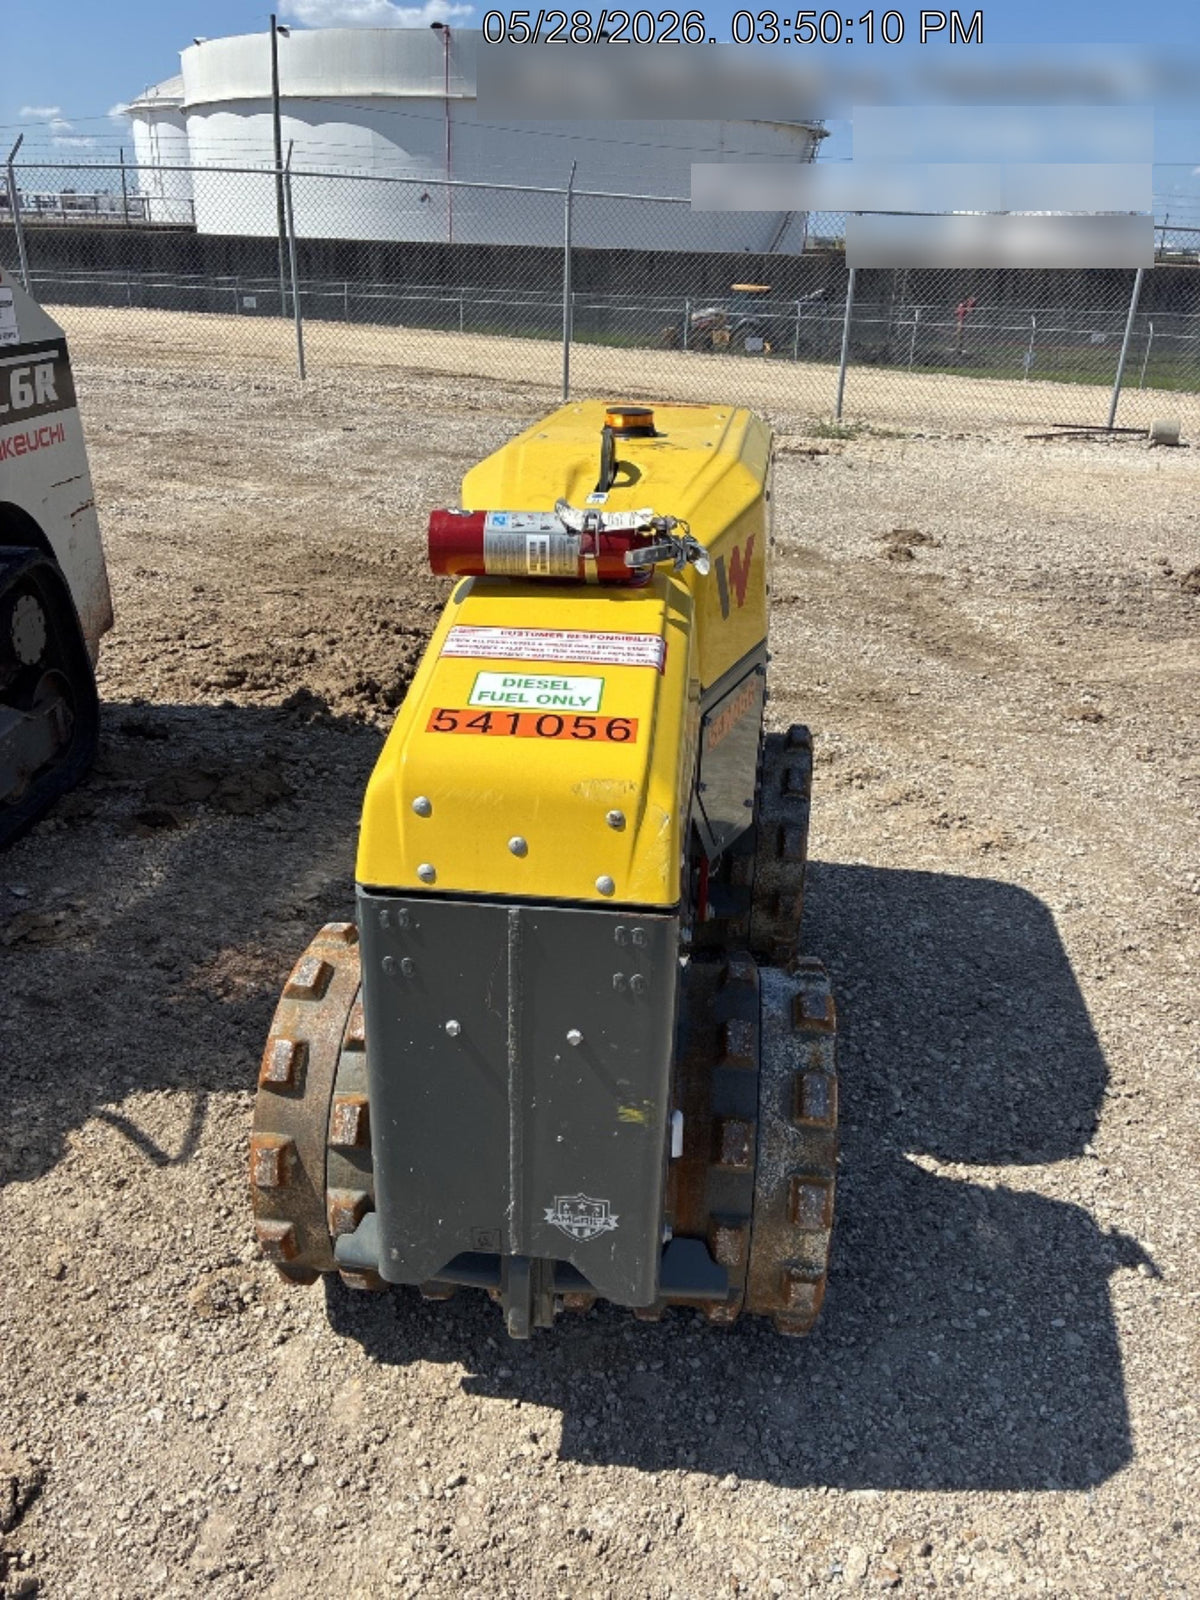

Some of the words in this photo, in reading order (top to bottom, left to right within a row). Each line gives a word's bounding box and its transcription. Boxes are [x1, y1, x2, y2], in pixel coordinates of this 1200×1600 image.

[500, 630, 564, 640] CUSTOMER
[566, 633, 662, 643] RESPONSIBILITY
[502, 677, 574, 691] DIESEL
[477, 690, 529, 703] FUEL
[536, 693, 592, 707] ONLY
[432, 708, 631, 742] 541056
